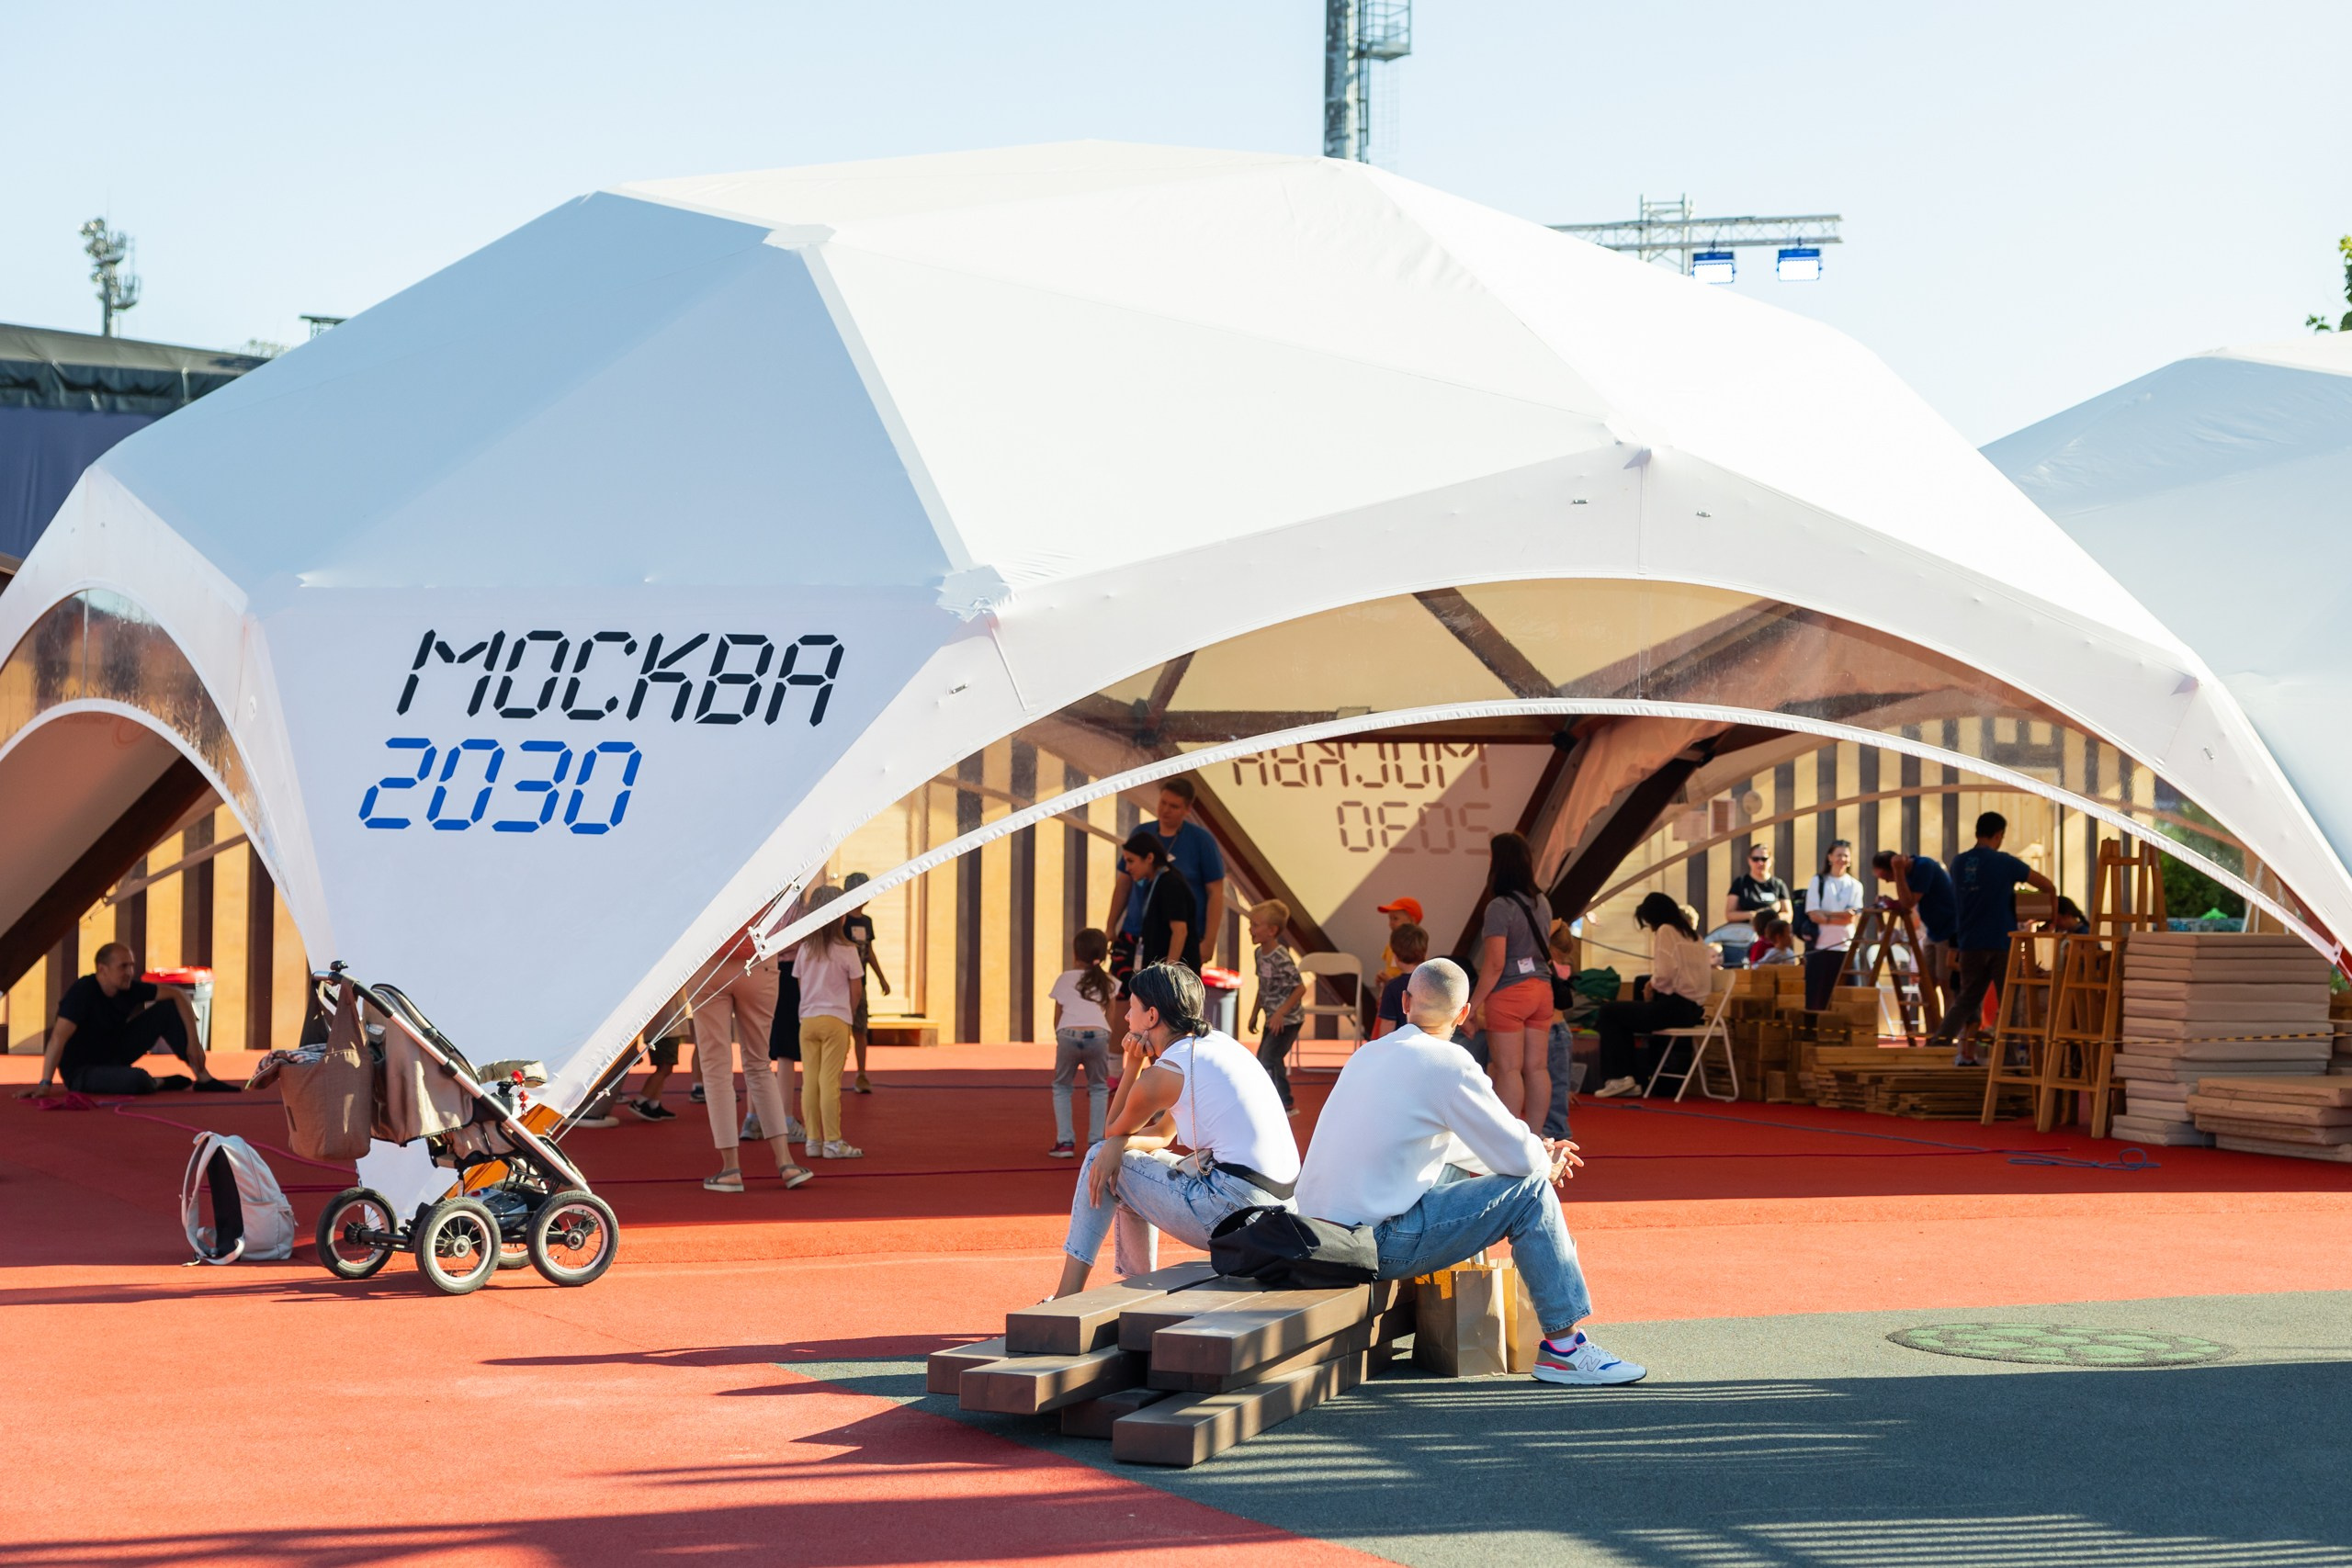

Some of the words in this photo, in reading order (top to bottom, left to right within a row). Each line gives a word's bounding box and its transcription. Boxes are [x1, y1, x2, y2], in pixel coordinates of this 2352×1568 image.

[396, 628, 844, 728] МОСКВА
[358, 737, 642, 835] 2030
[1577, 1354, 1601, 1372] N
